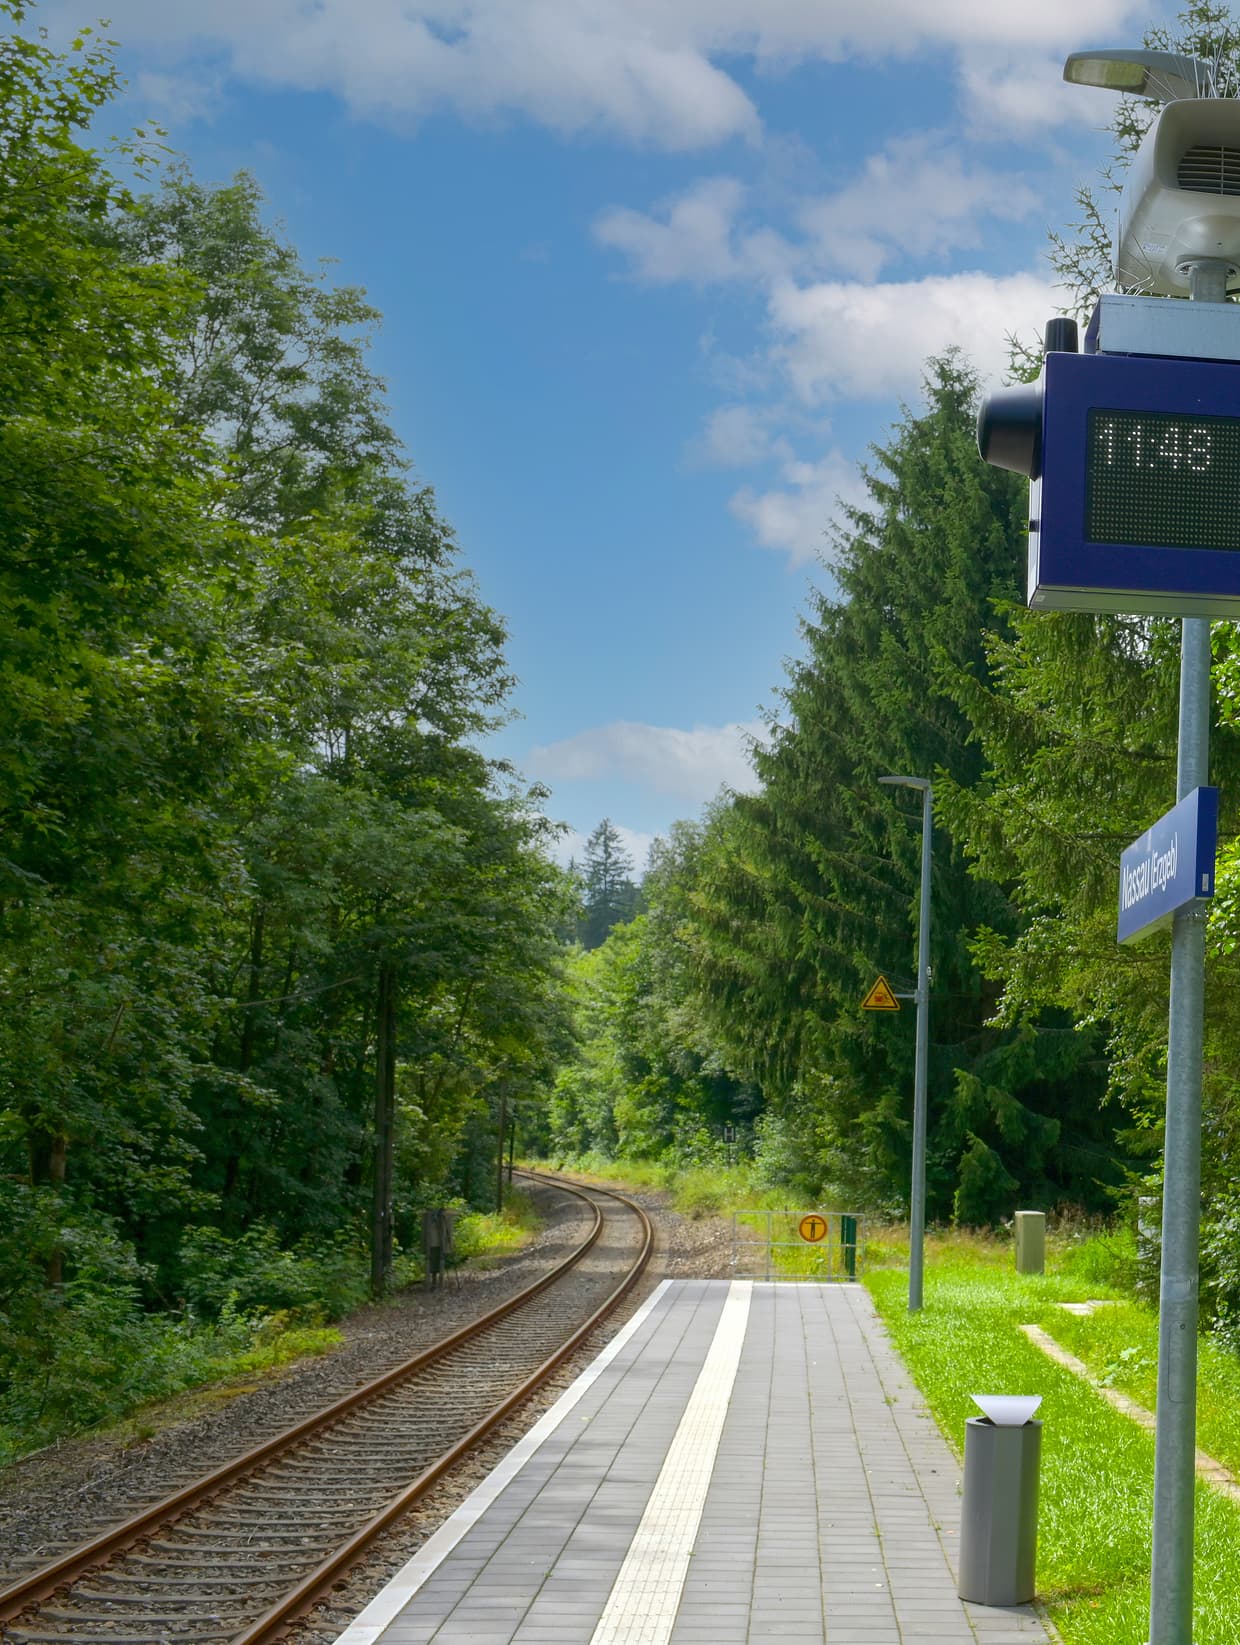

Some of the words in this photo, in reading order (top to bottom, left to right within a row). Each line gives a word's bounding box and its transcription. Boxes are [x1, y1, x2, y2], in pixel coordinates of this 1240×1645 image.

[1099, 423, 1211, 471] 11:48
[1121, 859, 1150, 912] Nassau
[1151, 832, 1178, 894] (Erzgeb)
[724, 1127, 734, 1141] H
